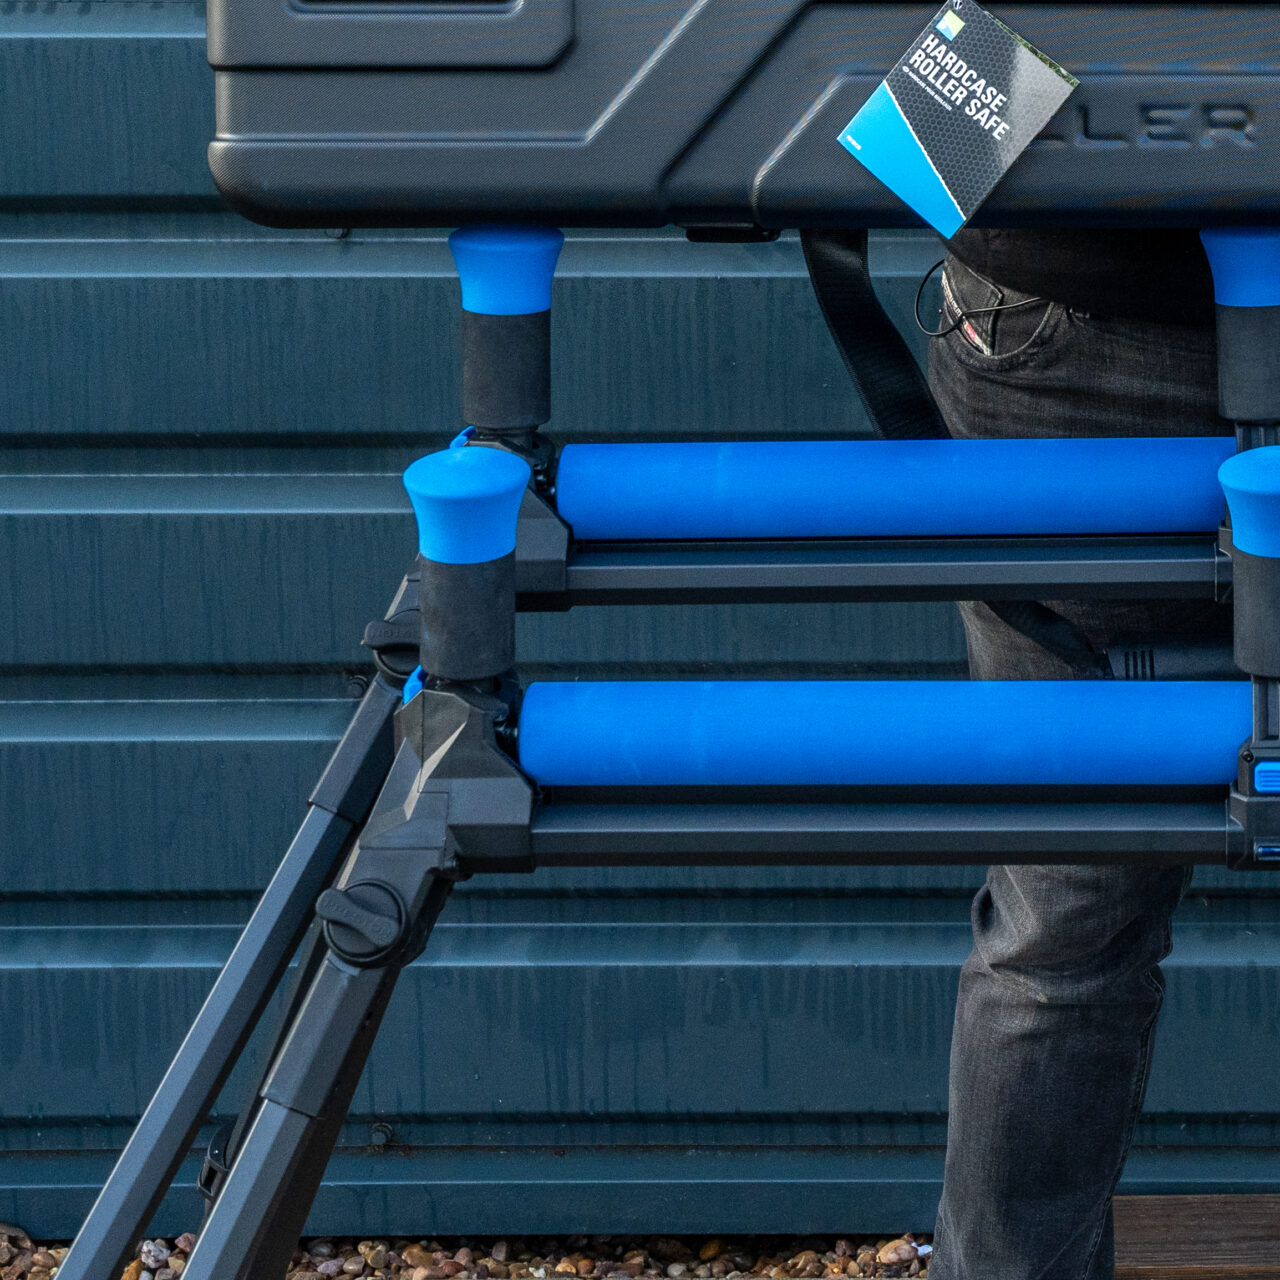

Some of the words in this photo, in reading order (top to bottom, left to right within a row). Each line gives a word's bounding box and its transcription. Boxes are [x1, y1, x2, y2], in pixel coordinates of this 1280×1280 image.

[909, 49, 968, 107] ROLLER
[964, 97, 1010, 141] SAFE
[921, 33, 1007, 113] HARDCASE
[1030, 103, 1257, 148] LER
